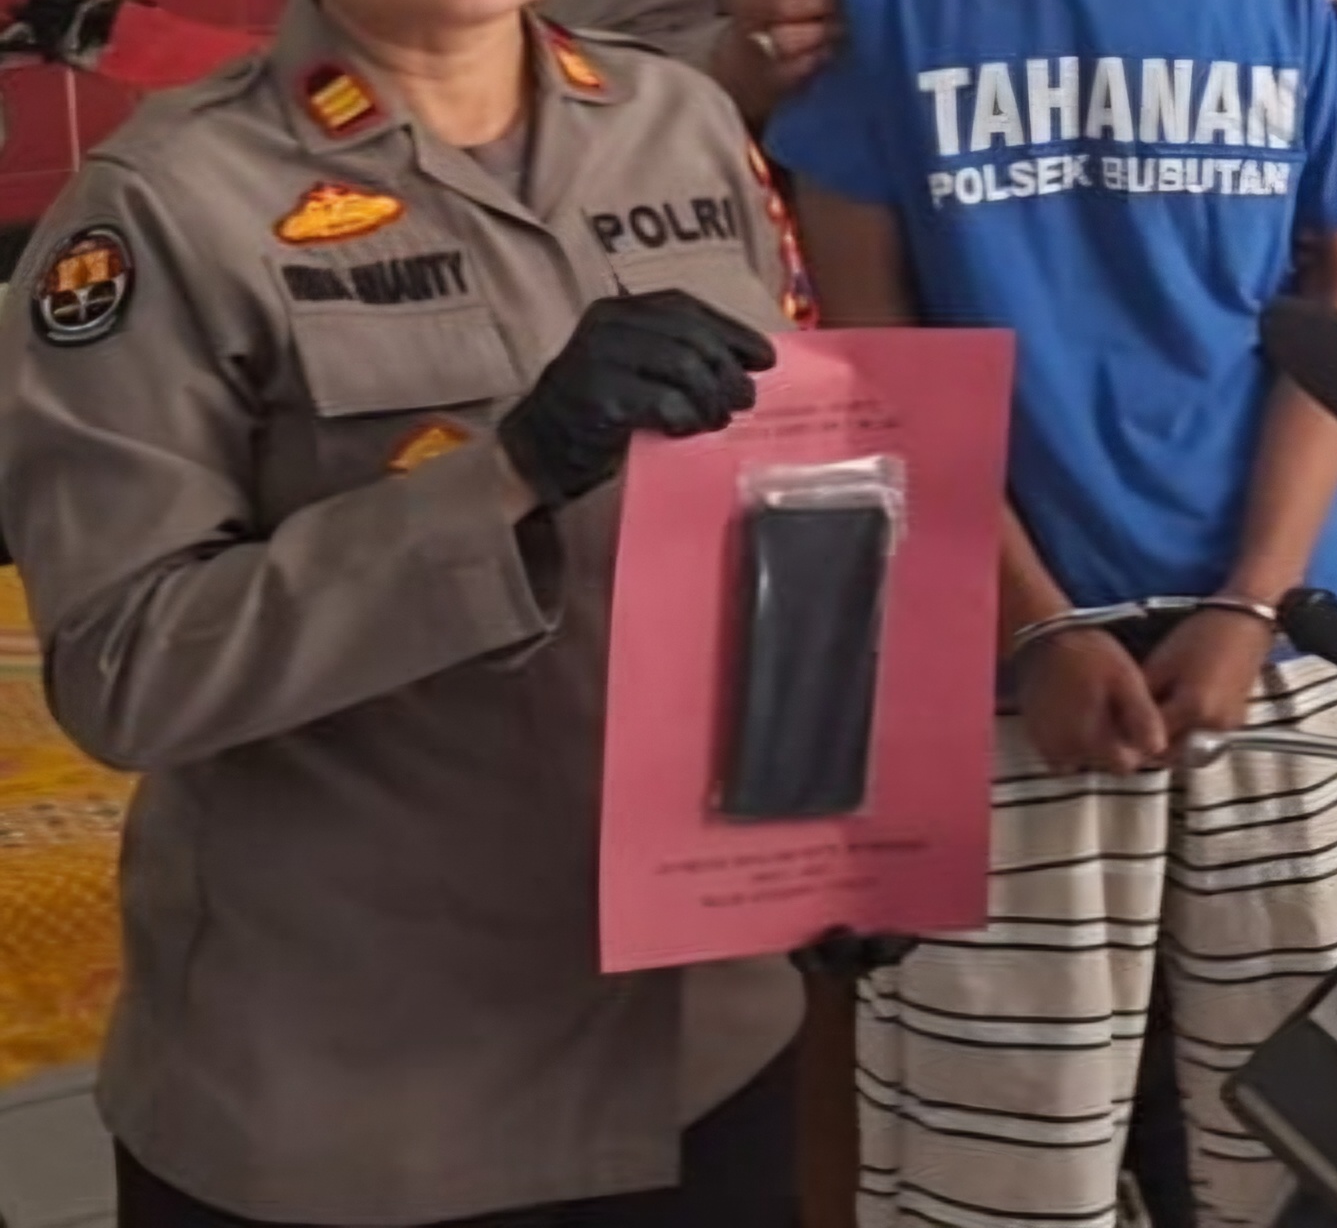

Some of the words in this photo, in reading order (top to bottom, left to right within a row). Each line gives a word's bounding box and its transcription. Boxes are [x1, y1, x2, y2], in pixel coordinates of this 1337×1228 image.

[917, 55, 1299, 157] TAHANAN
[928, 154, 1092, 210] POLSEK
[1102, 156, 1291, 196] BUBUTAN
[592, 197, 737, 254] POLRI
